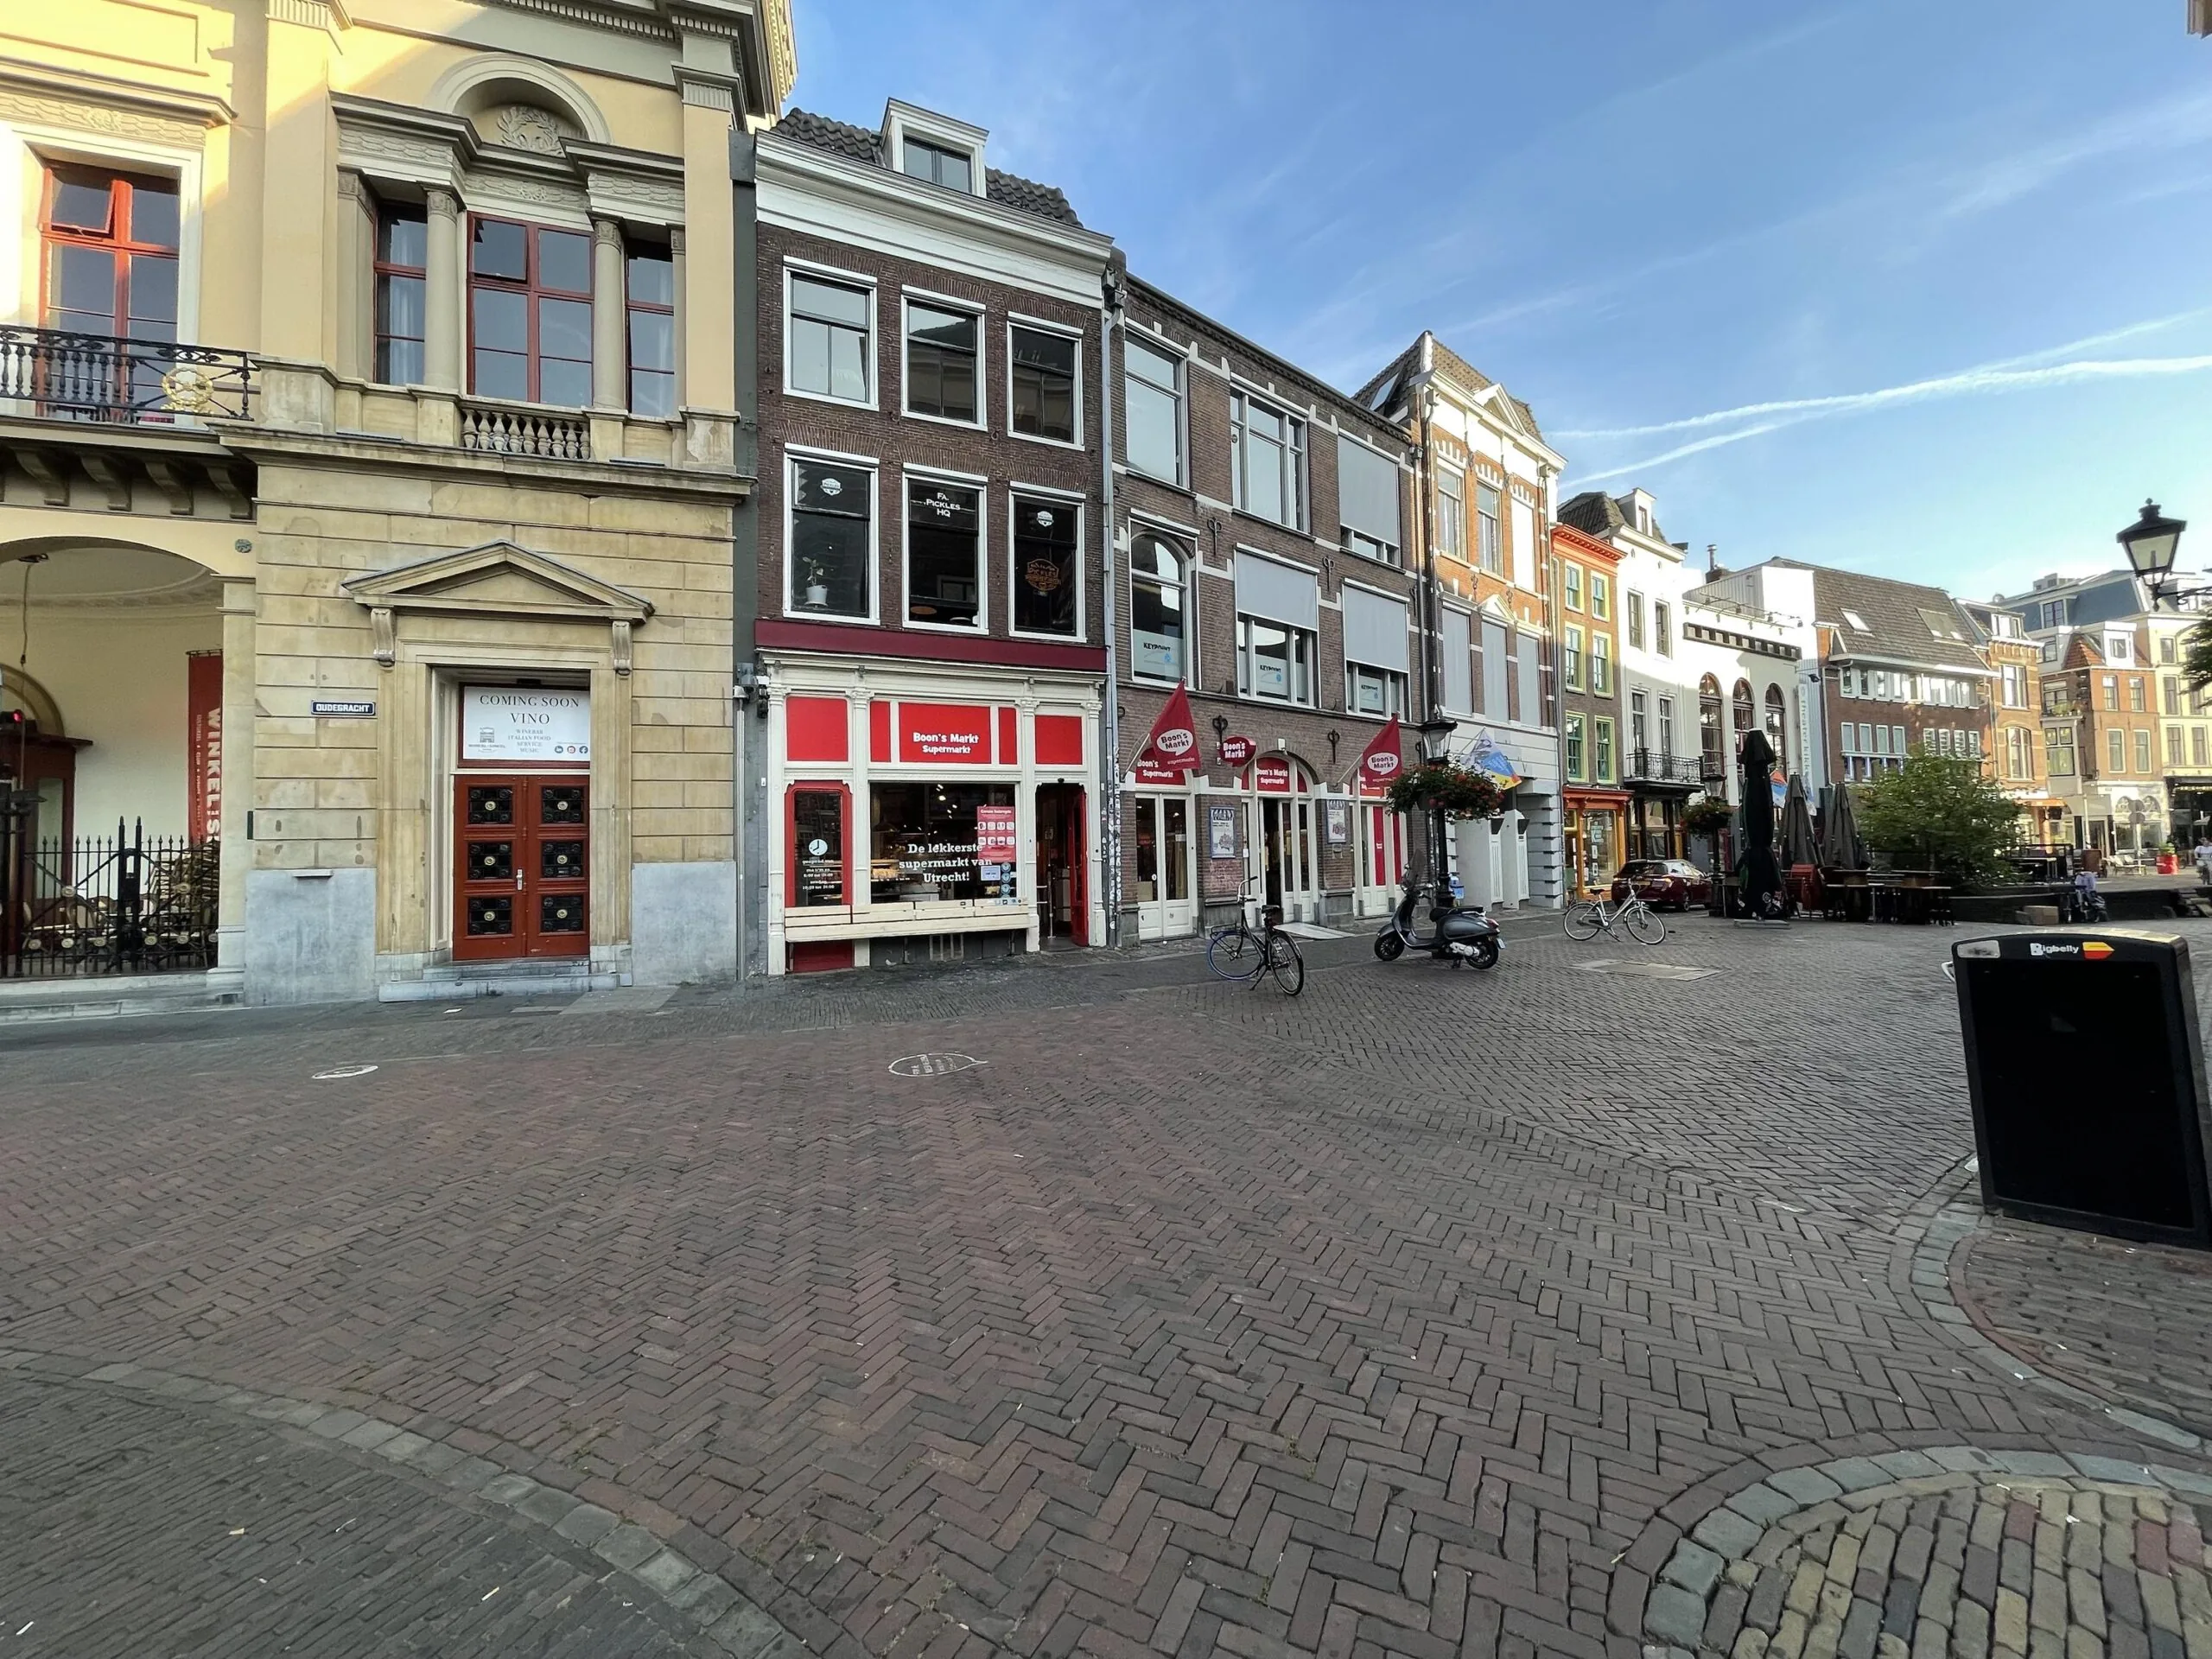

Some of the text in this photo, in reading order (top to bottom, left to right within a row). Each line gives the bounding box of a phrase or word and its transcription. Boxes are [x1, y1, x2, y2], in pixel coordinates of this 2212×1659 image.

[937, 492, 950, 501] FA.
[925, 498, 961, 511] PICKLES
[937, 508, 951, 518] HQ
[1143, 642, 1171, 652] KEYPOINT
[480, 695, 580, 708] COMING SOON
[315, 703, 371, 713] OUDEGRACHT
[511, 712, 550, 725] VINO
[912, 732, 980, 744] Boon's Markt
[1160, 732, 1188, 743] Boon's
[922, 744, 971, 755] Supermarkt
[1165, 739, 1190, 750] Markt
[1223, 741, 1246, 751] Boon's
[1224, 749, 1246, 759] Markt
[1137, 760, 1160, 768] Boon's
[1142, 769, 1174, 778] Supermarkt
[1274, 768, 1288, 777] Markt
[907, 842, 983, 854] De lekkerste
[899, 857, 993, 870] supermarkt van
[923, 871, 969, 882] Utrecht!
[2030, 943, 2079, 956] Bigbelly
